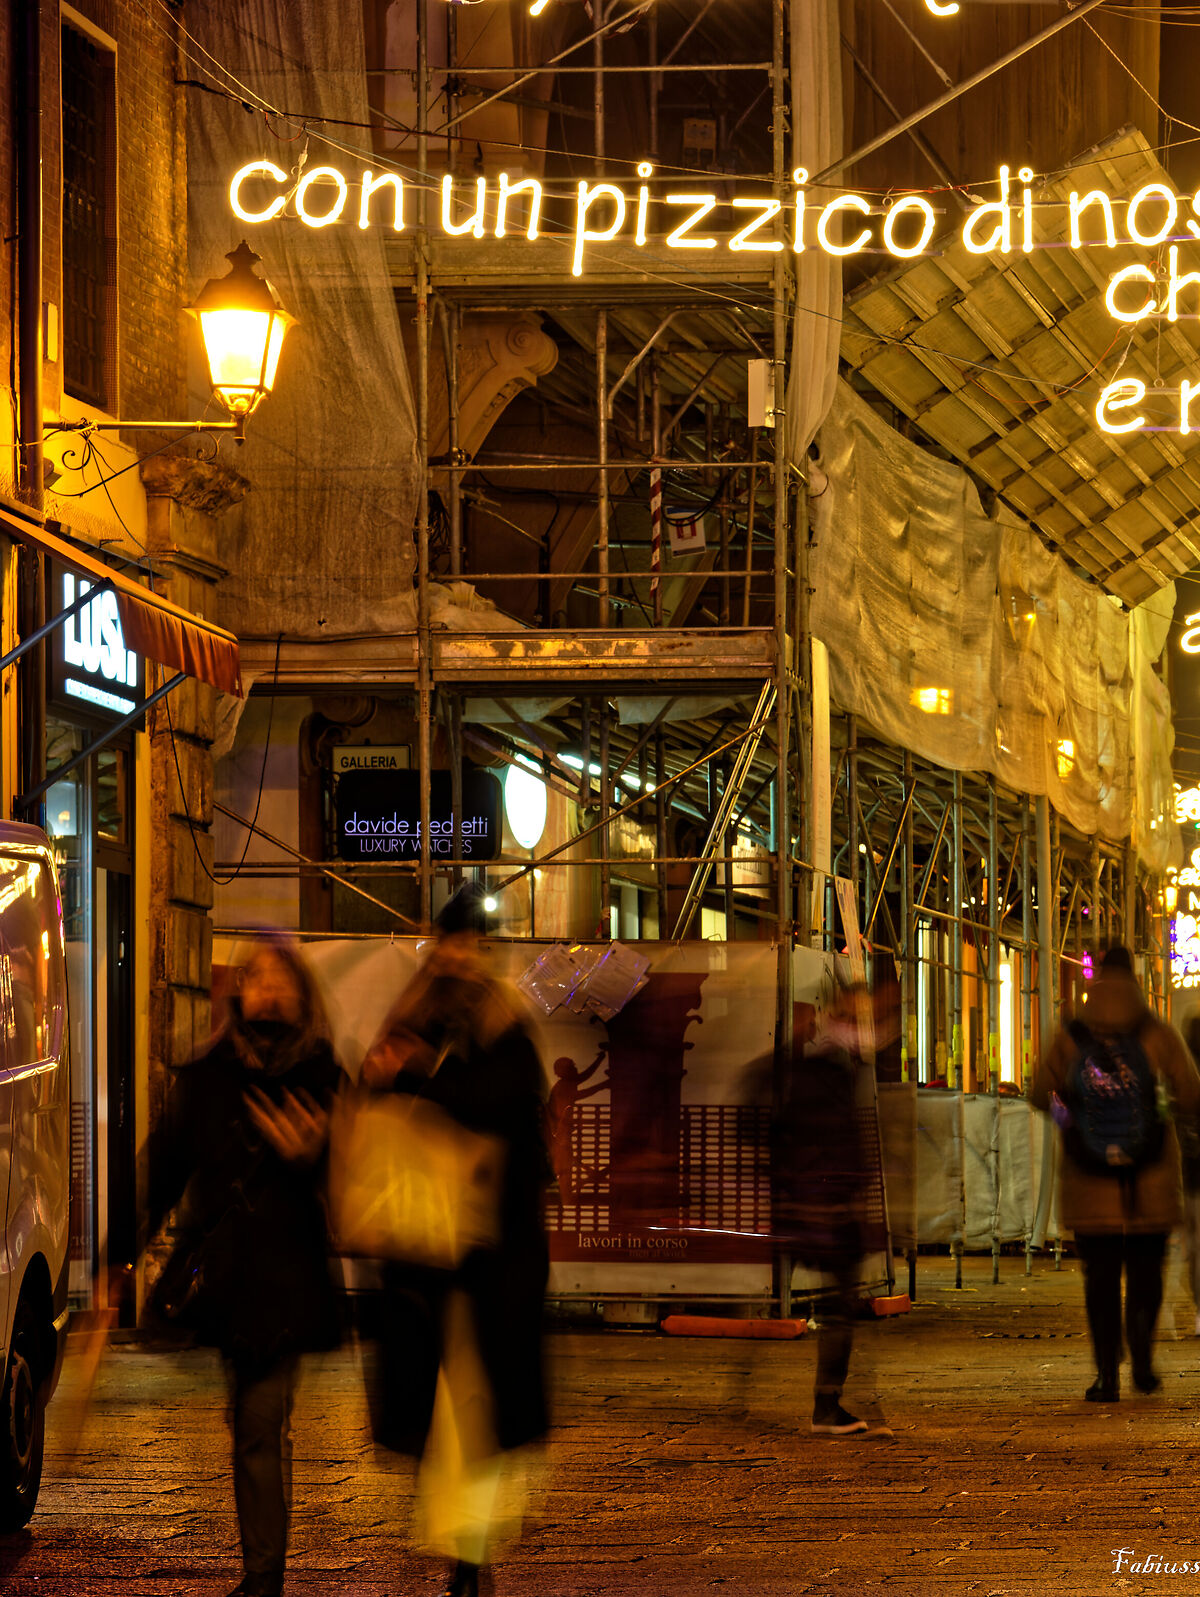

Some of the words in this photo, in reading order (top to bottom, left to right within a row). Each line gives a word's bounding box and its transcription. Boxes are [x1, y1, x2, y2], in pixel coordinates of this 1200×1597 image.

[229, 159, 405, 231] con
[441, 172, 543, 241] un
[572, 161, 937, 276] pizzico
[961, 164, 1036, 254] di
[1095, 376, 1147, 436] e
[340, 756, 397, 769] GALLERIA
[344, 812, 410, 835] davide
[416, 812, 489, 839] pedetti
[360, 838, 407, 853] LUXURY
[578, 1233, 622, 1248] lavori
[628, 1233, 642, 1248] in
[647, 1235, 689, 1249] corso
